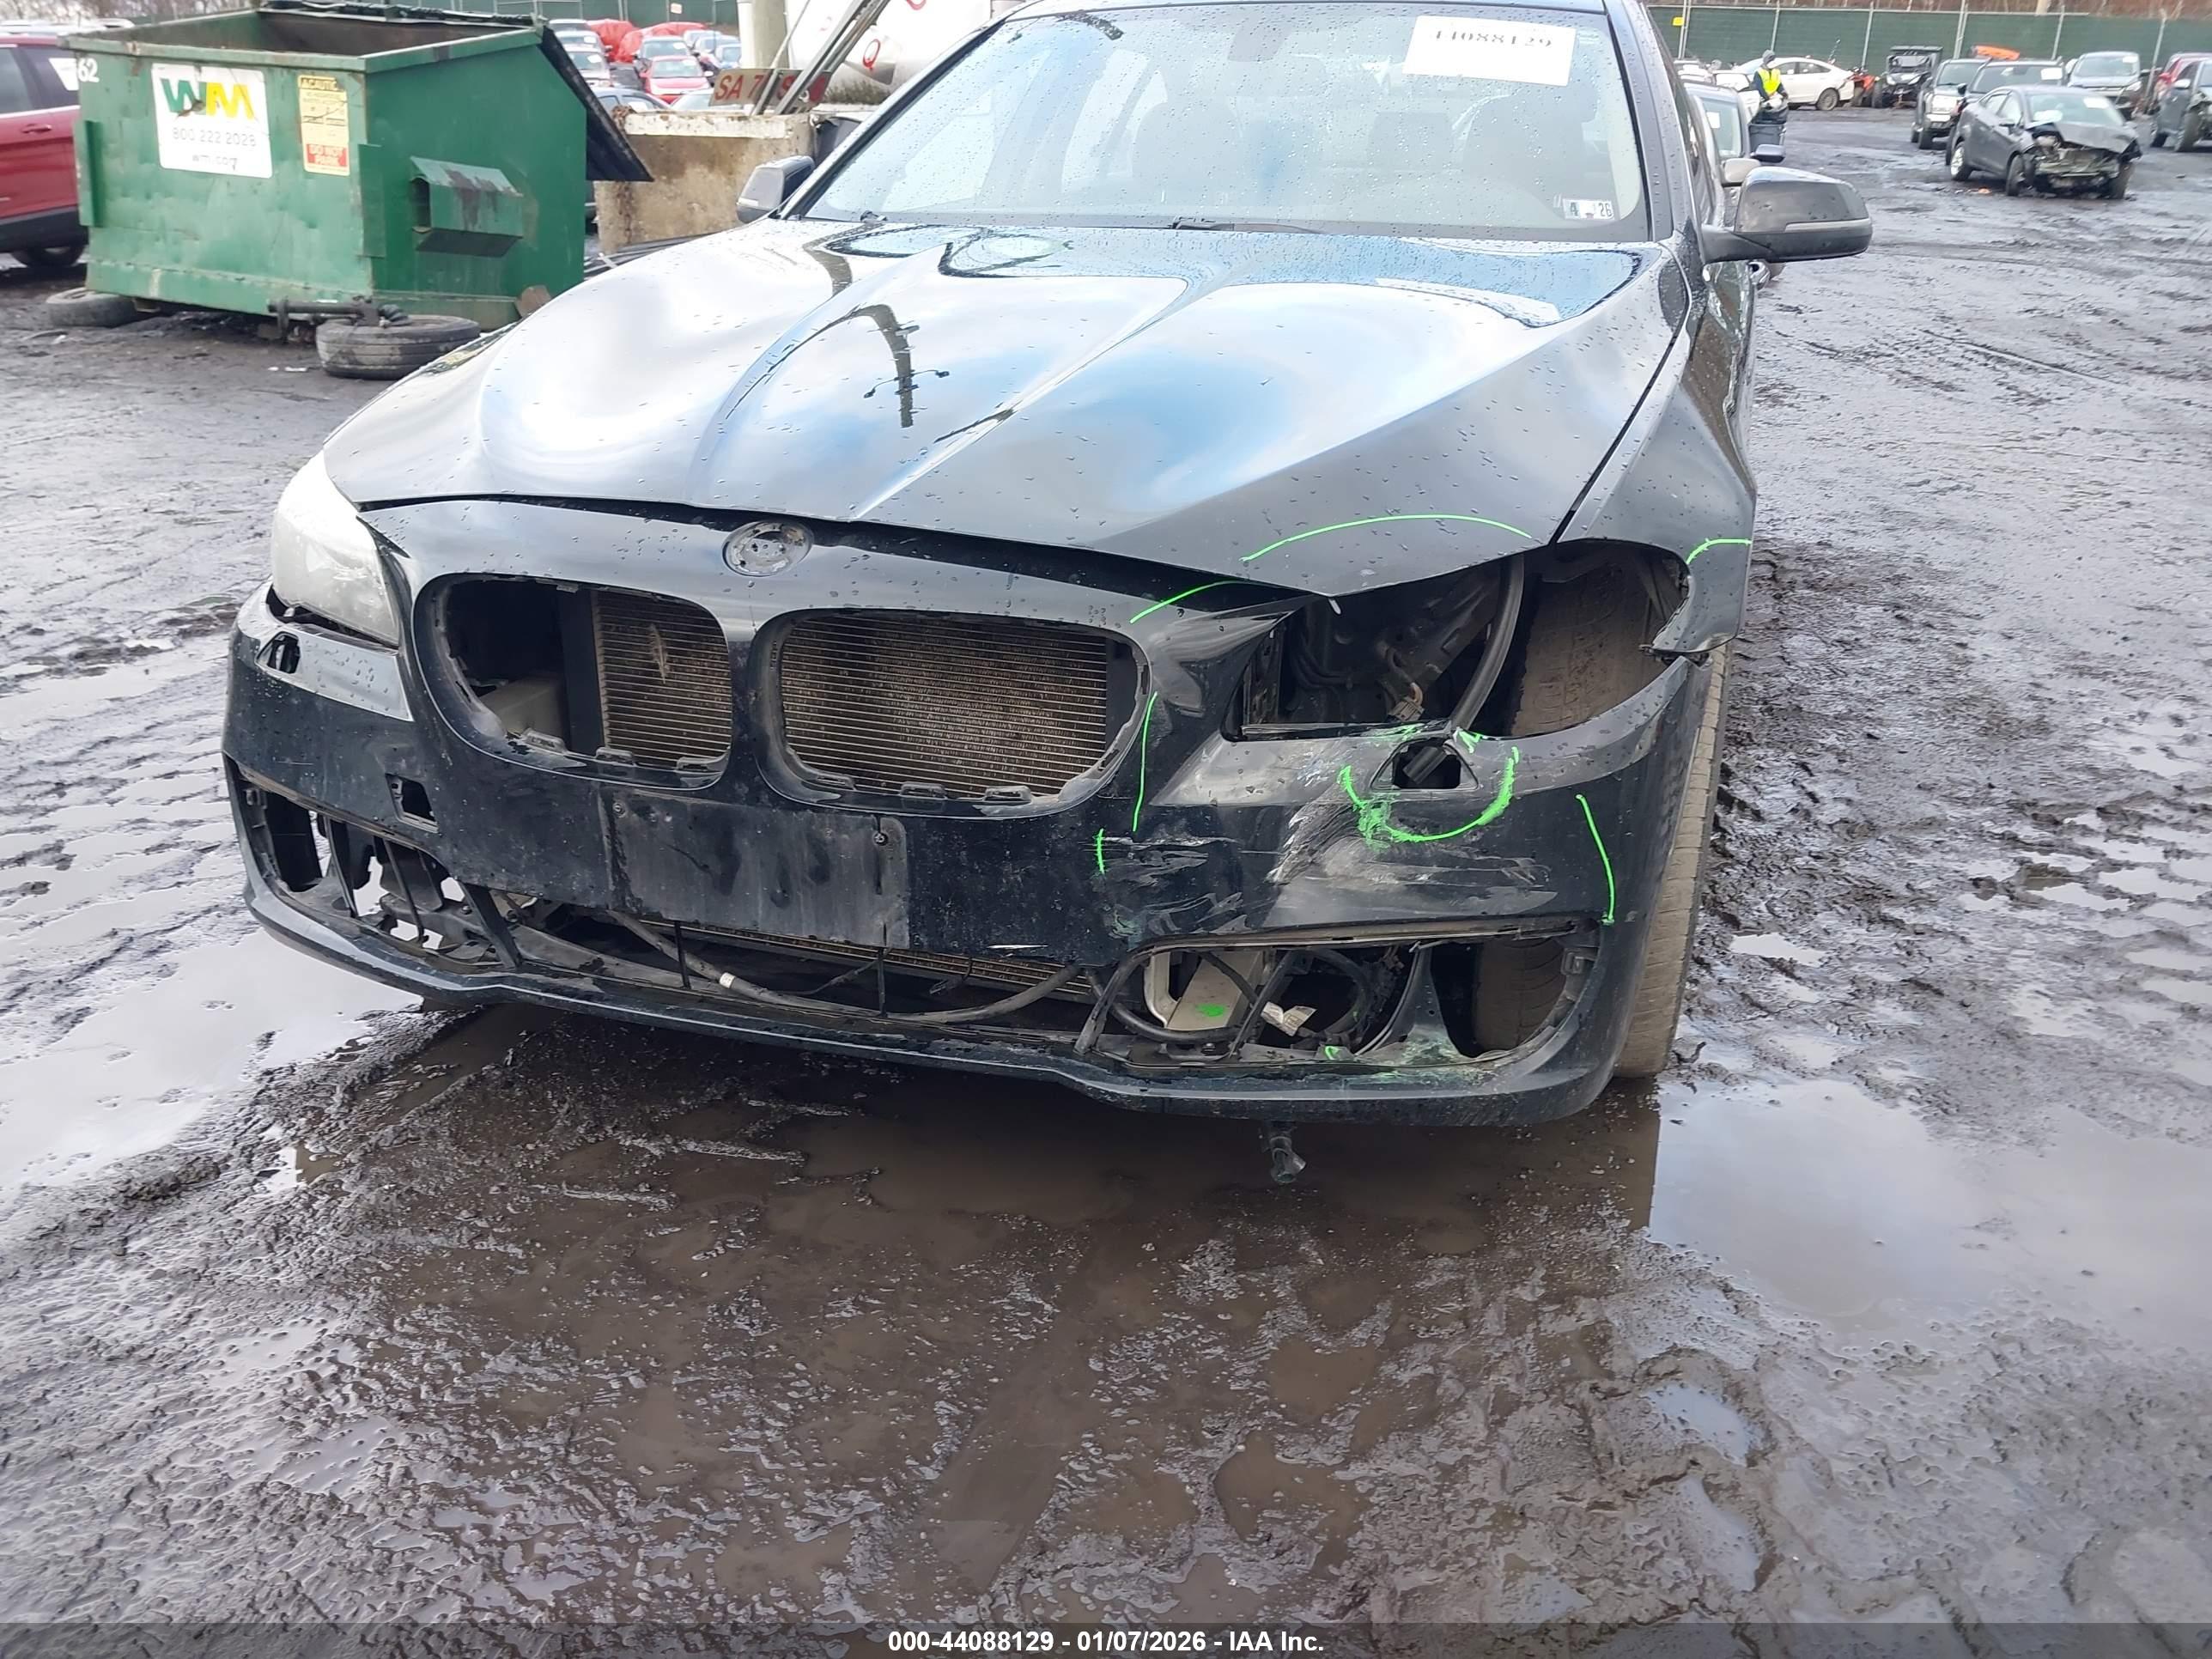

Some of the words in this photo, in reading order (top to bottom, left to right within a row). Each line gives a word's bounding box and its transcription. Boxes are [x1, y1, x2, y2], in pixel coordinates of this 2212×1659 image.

[77, 58, 100, 82] 62
[160, 77, 255, 121] WM
[714, 74, 744, 101] SA
[199, 130, 221, 144] 222
[1598, 203, 1613, 217] 26
